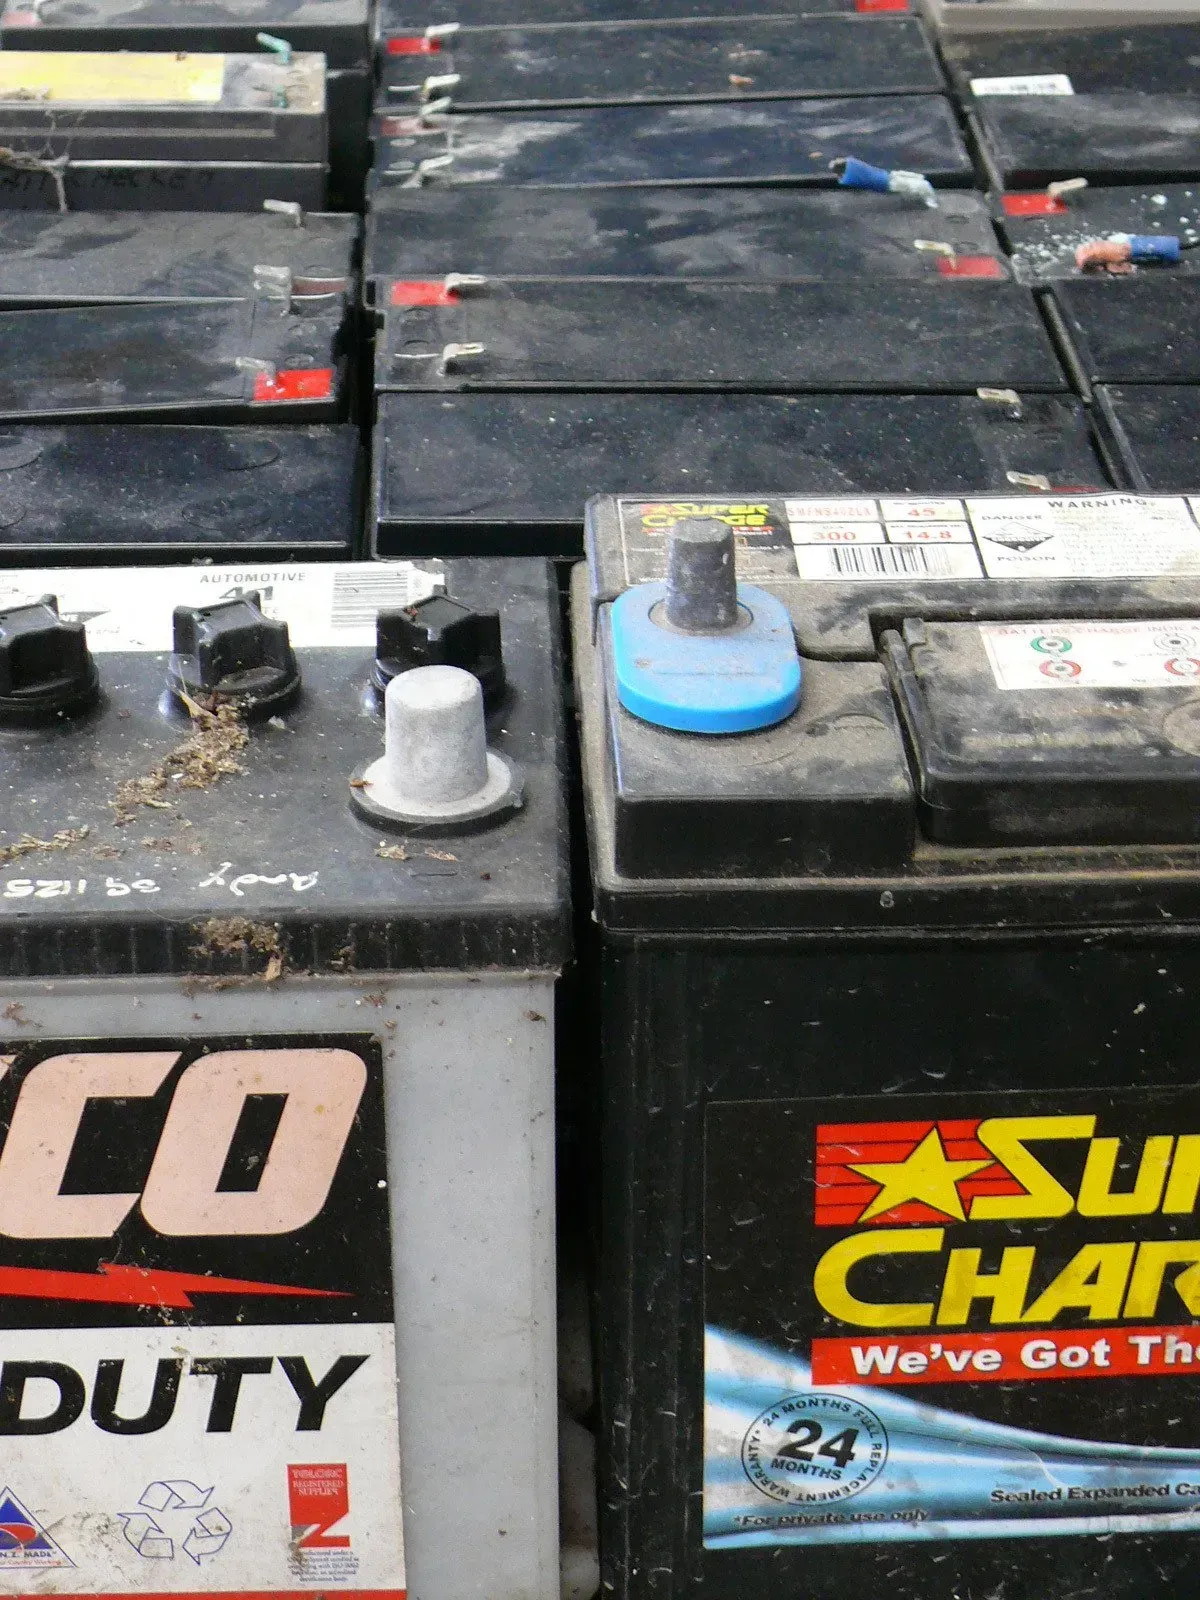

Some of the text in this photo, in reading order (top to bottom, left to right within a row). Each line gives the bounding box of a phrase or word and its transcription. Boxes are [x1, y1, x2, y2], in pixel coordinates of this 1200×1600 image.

[671, 503, 770, 515] SUPER
[1048, 497, 1148, 508] WARNING
[907, 508, 936, 517] 45
[813, 531, 857, 541] 300
[903, 531, 953, 540] 14.8
[200, 572, 307, 583] AUTOMOTIVE
[0, 1048, 367, 1239] CO
[851, 1343, 1003, 1376] We've
[1020, 1339, 1111, 1370] Got
[0, 1354, 371, 1436] DUTY
[781, 1398, 852, 1414] MONTHS
[762, 1412, 780, 1427] 24
[776, 1418, 860, 1469] 24
[748, 1435, 790, 1498] WARRANTY
[770, 1457, 843, 1481] MONTHS
[796, 1442, 883, 1502] REPLACEMENT
[990, 1488, 1062, 1502] Sealed
[1067, 1483, 1170, 1501] Expanded
[850, 1512, 886, 1522] use
